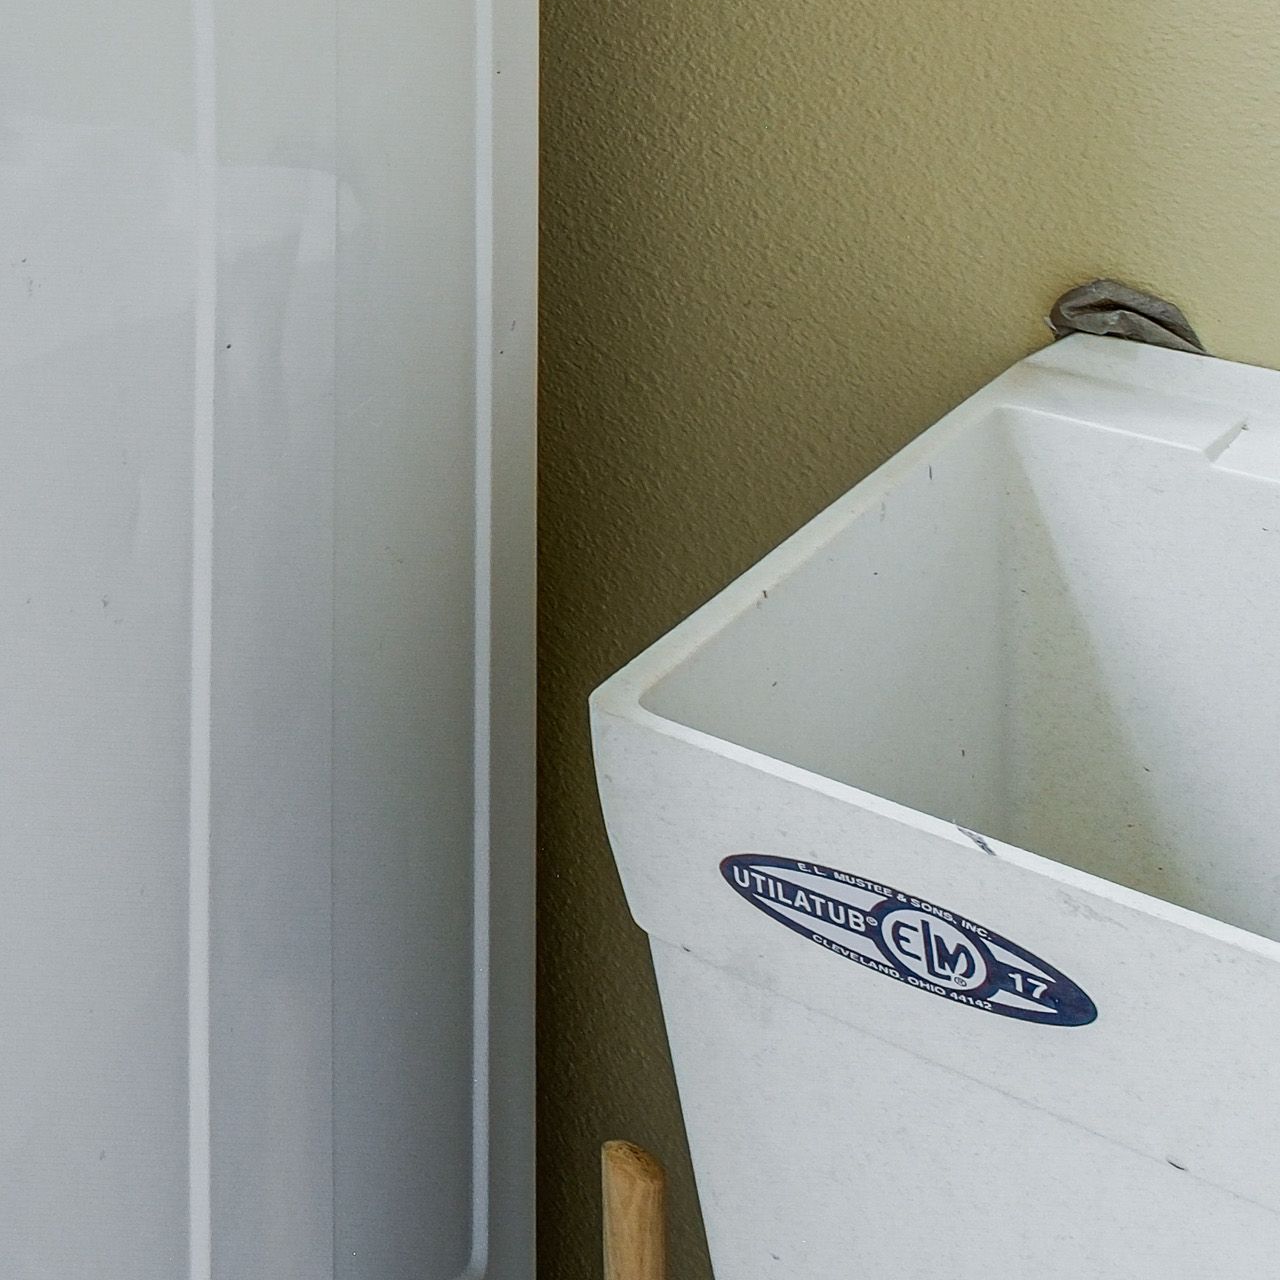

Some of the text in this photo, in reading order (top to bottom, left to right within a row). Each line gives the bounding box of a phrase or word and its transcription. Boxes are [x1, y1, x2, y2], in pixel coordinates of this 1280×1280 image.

[797, 862, 810, 873] E.
[834, 872, 893, 897] MUSTEE
[896, 893, 907, 902] &
[961, 920, 993, 940] INC.
[907, 976, 947, 996] OHIO
[949, 991, 993, 1010] 44142
[1008, 973, 1048, 1000] 17
